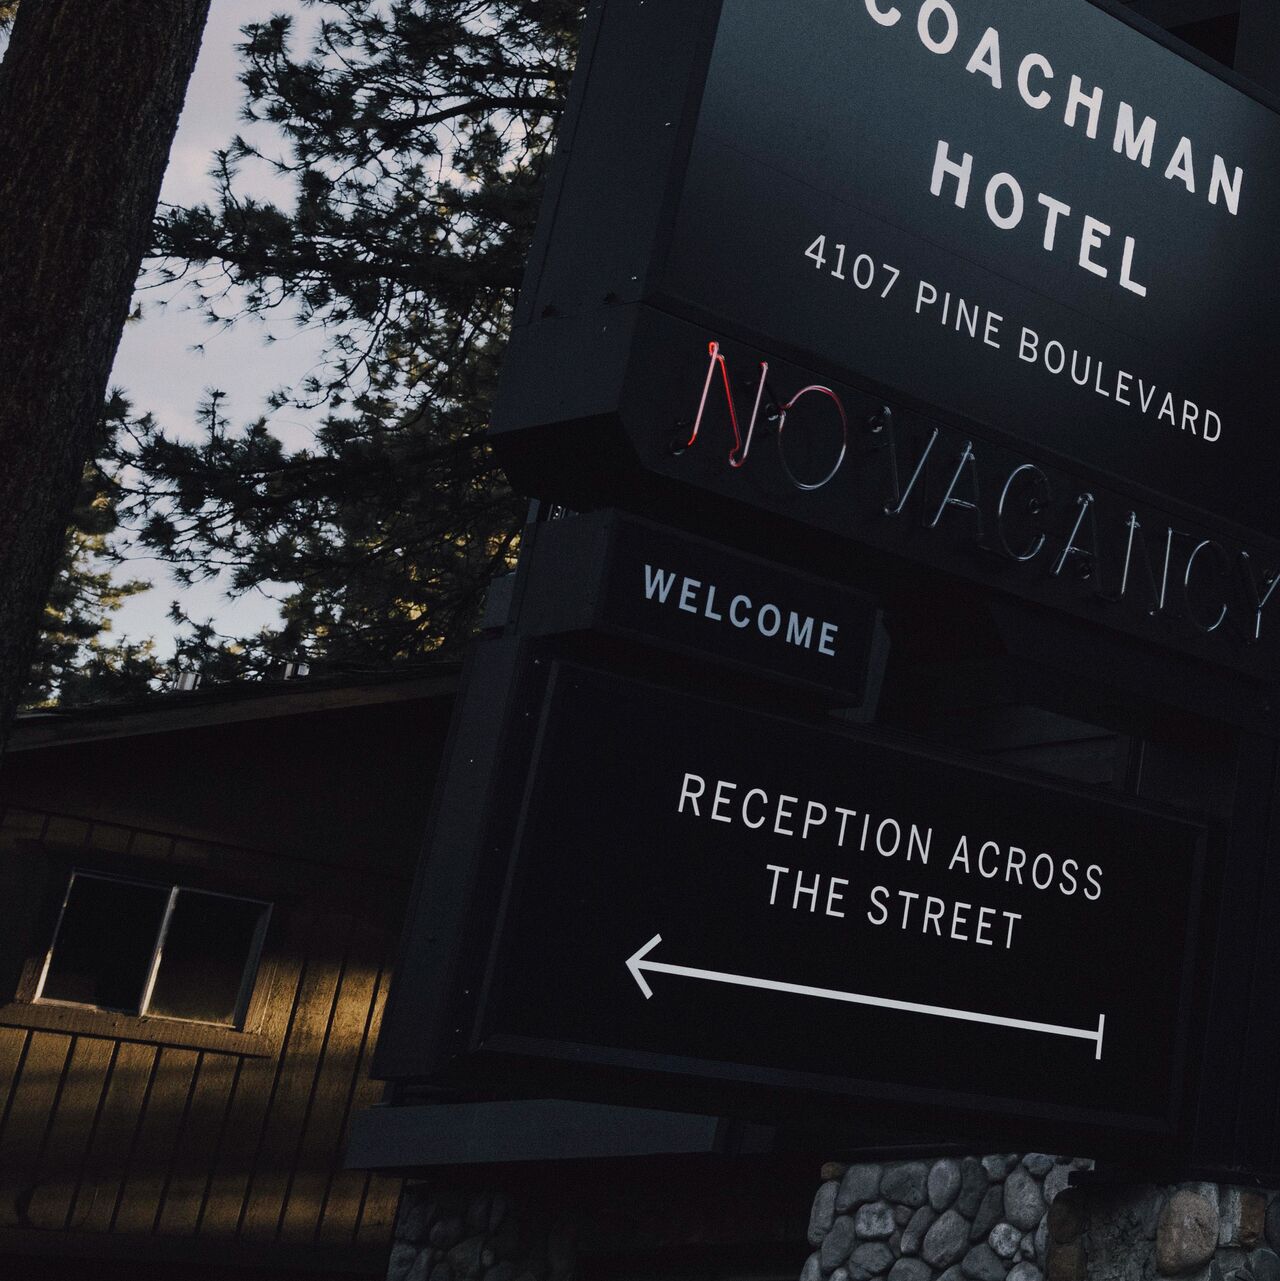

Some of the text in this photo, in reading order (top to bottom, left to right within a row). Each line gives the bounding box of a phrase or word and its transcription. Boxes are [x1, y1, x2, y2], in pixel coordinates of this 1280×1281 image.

[929, 139, 1147, 298] HOTEL
[804, 234, 1222, 442] 4107 PINE BOULEVARD
[682, 340, 849, 491] NO
[643, 564, 839, 657] WELCOME
[677, 772, 1104, 901] RECEPTION ACROSS
[766, 863, 1023, 950] THE STREET
